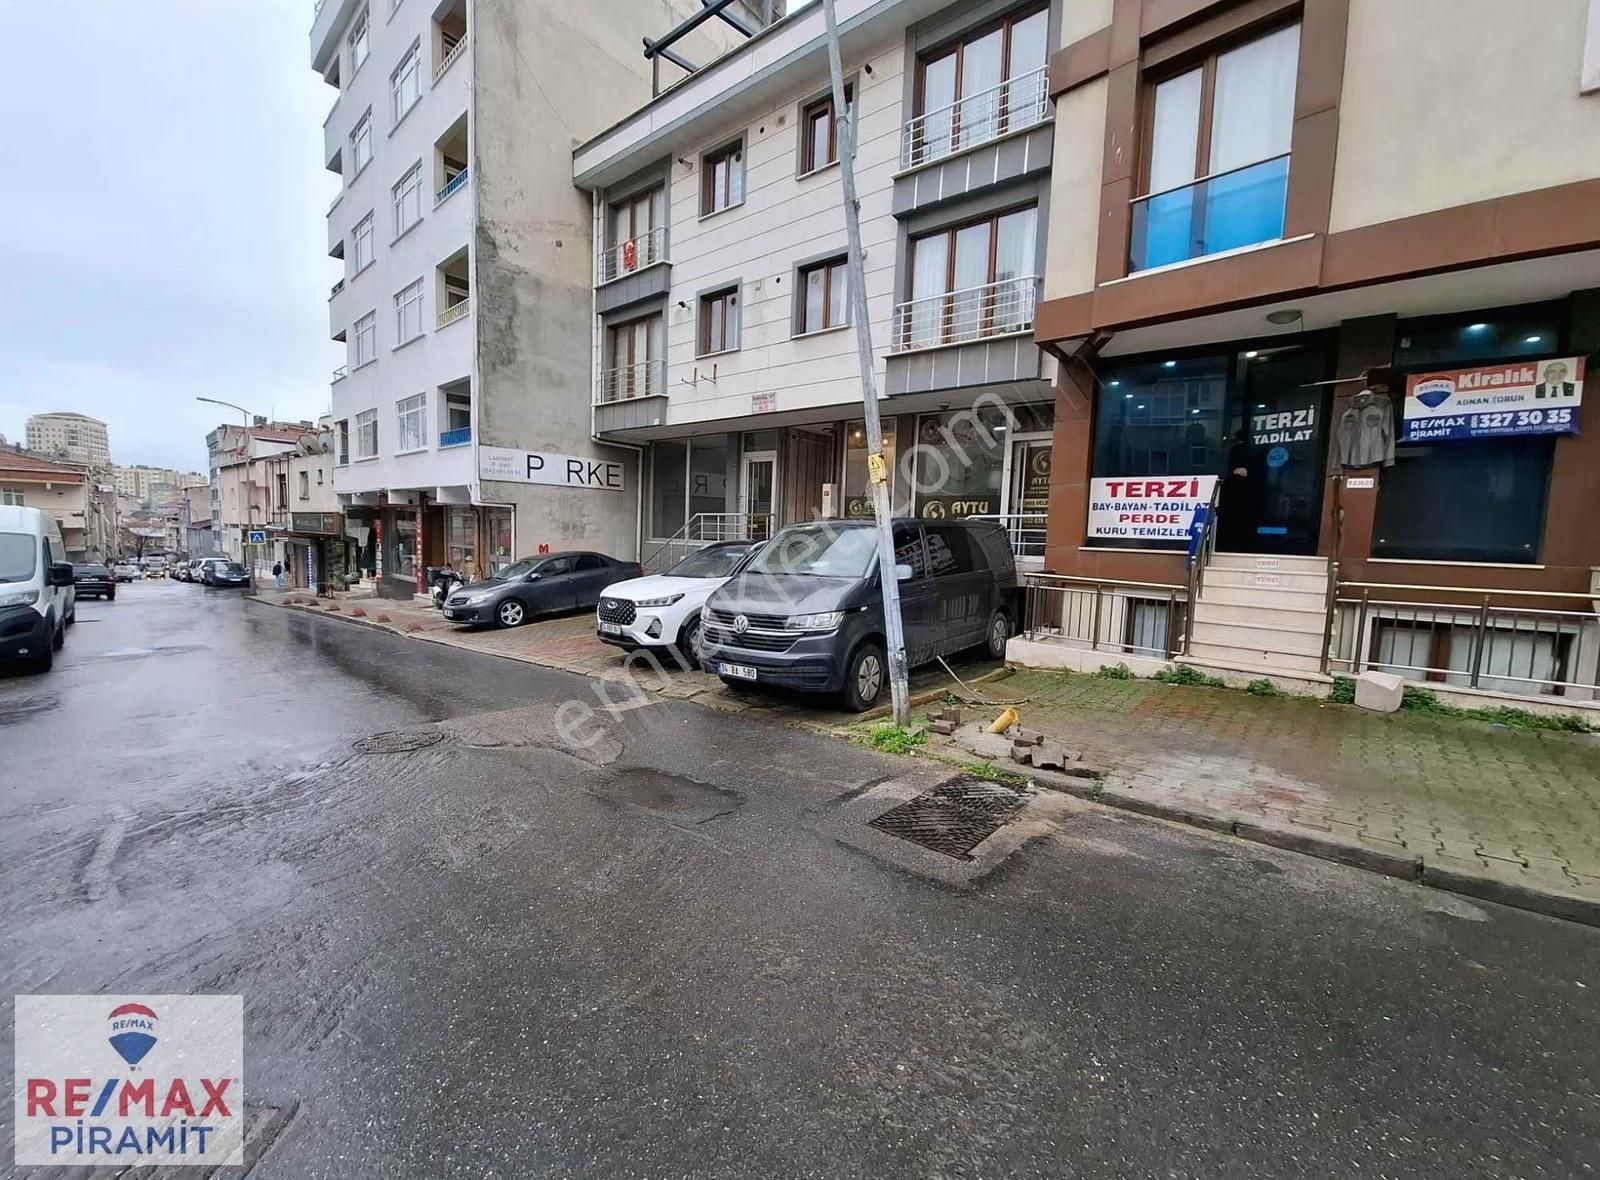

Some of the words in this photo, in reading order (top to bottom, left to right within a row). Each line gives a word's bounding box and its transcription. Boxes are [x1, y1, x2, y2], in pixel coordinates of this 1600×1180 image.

[1458, 368, 1534, 388] Kiralık
[1456, 398, 1489, 406] ADNAN
[1253, 404, 1315, 431] TERZİ
[1410, 417, 1465, 429] RE/MAX
[1480, 413, 1513, 428] 327
[1517, 410, 1542, 425] 30
[1547, 409, 1571, 423] 35
[1253, 430, 1313, 445] TADİLAT
[1105, 477, 1199, 498] TERZİ
[951, 501, 989, 515] AYTU
[1119, 514, 1180, 523] PERDE
[1096, 527, 1127, 535] KURU
